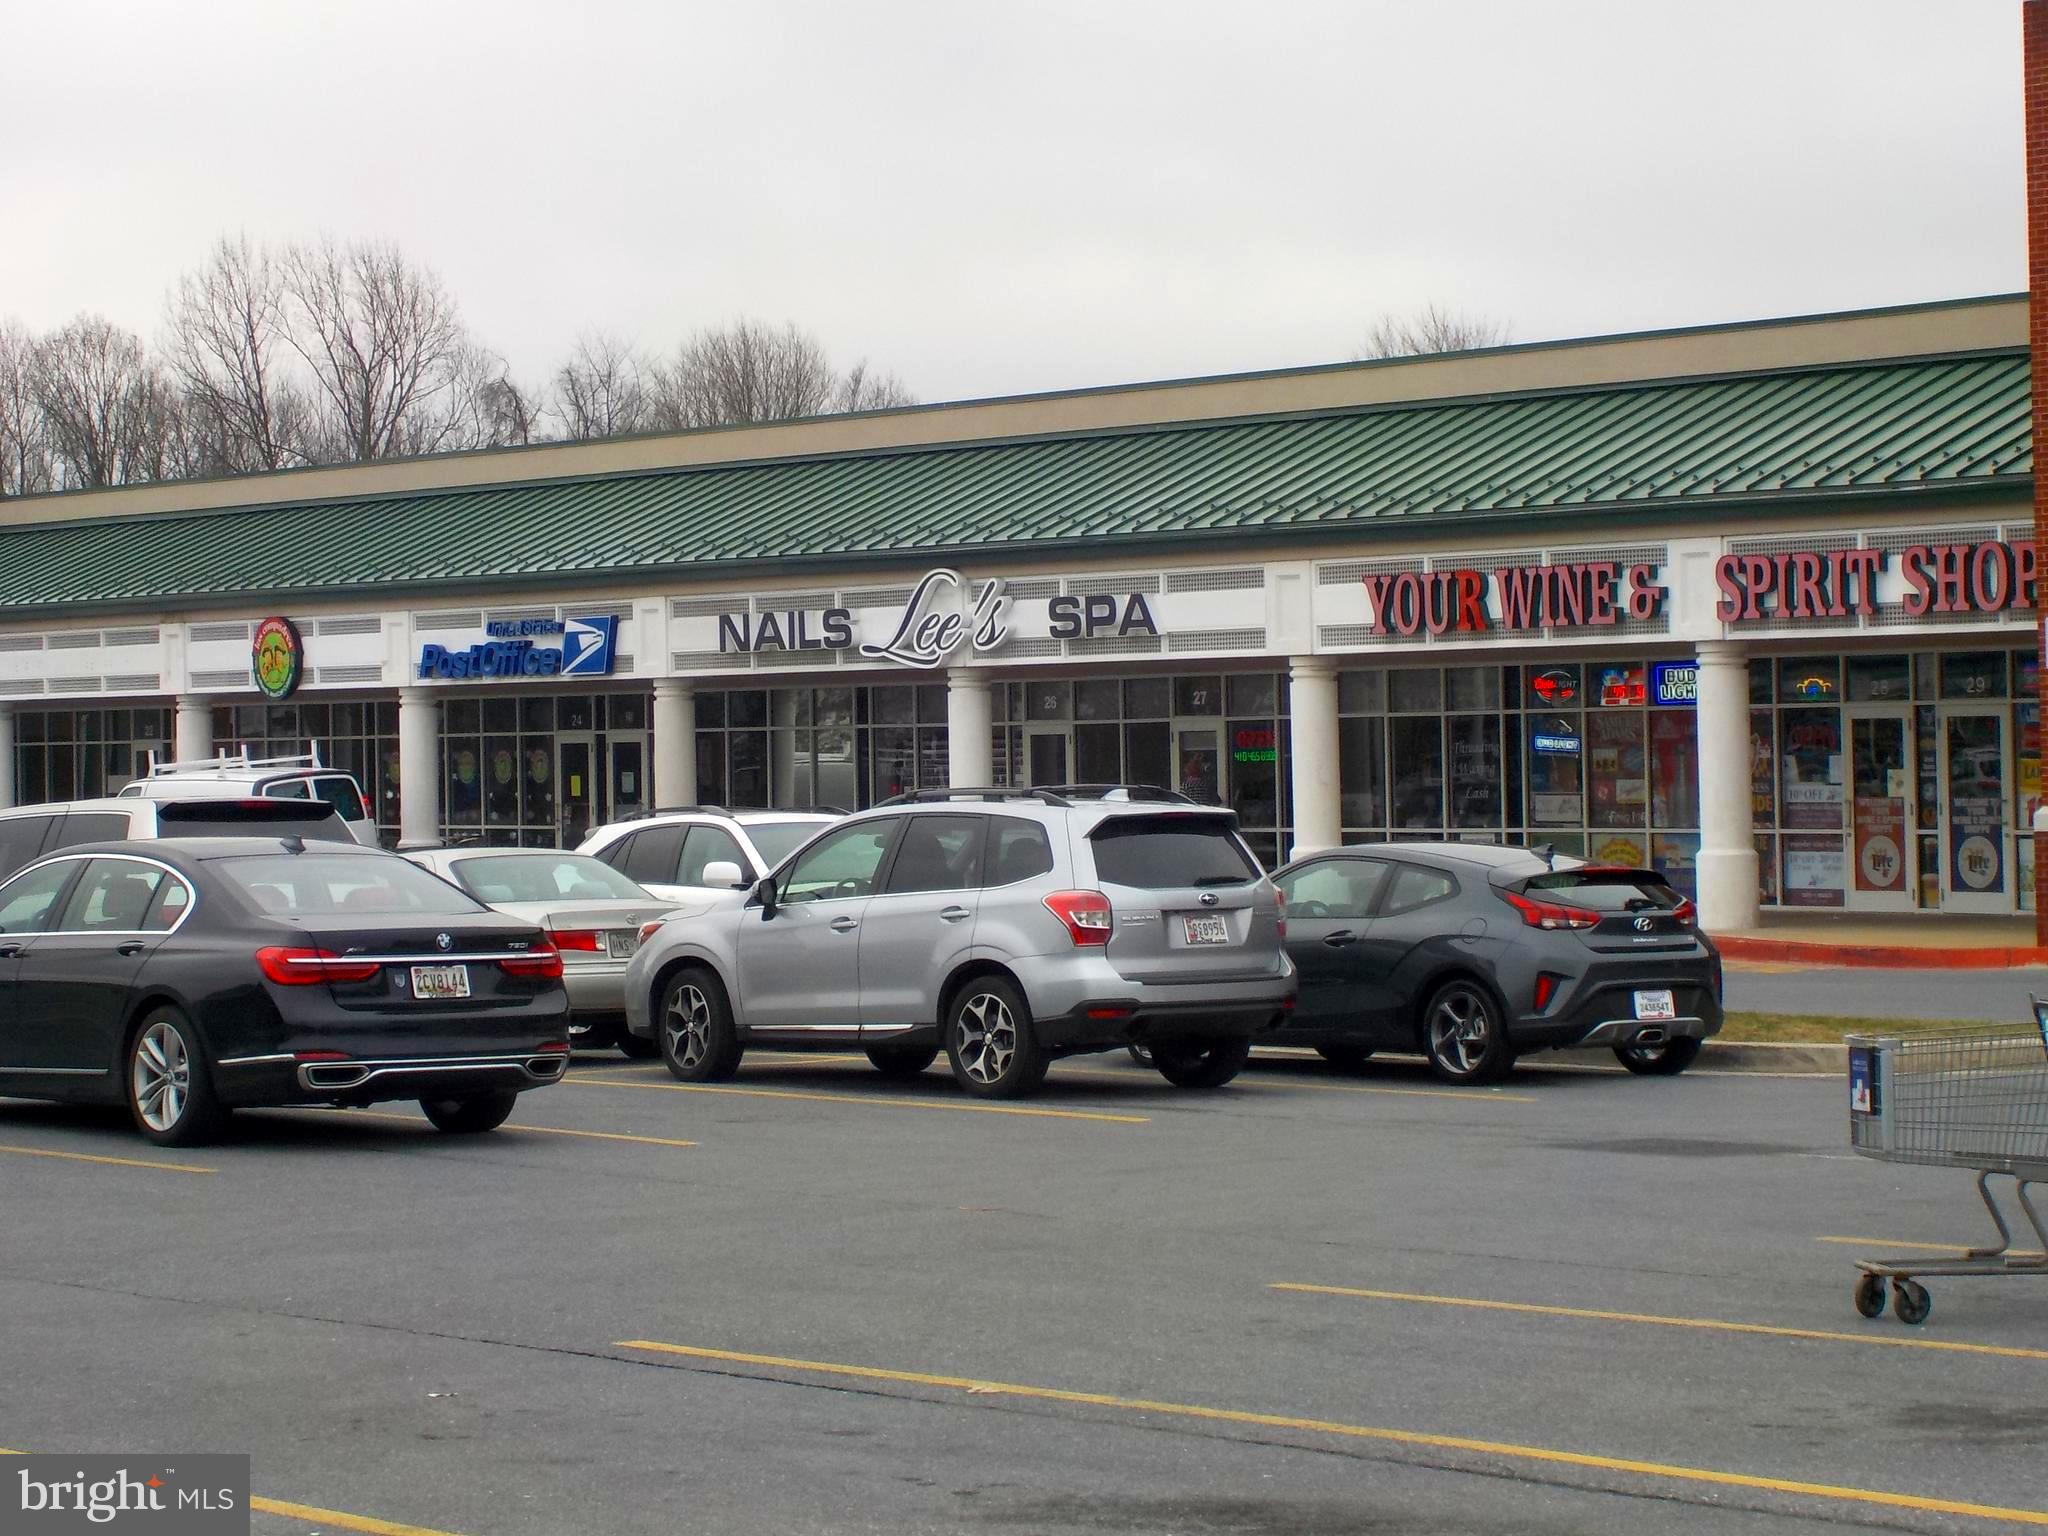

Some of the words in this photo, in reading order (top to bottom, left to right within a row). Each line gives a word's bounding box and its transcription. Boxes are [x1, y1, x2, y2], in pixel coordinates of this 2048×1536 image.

[1715, 549, 1882, 622] SPIRIT
[1361, 569, 1487, 636] YOUR
[1494, 562, 1620, 630] WINE
[1629, 563, 1663, 620] &
[860, 568, 1011, 669] Lee's
[1047, 593, 1159, 639] SPA
[486, 621, 521, 638] United
[521, 619, 562, 636] States
[718, 607, 853, 653] NAILS
[419, 644, 481, 680] Post
[479, 640, 563, 677] Office
[1665, 668, 1697, 684] BUD
[1967, 677, 1985, 693] 29
[1193, 691, 1207, 705] 27
[1660, 684, 1697, 700] LIGH
[1044, 696, 1057, 709] 26
[571, 714, 582, 727] 24
